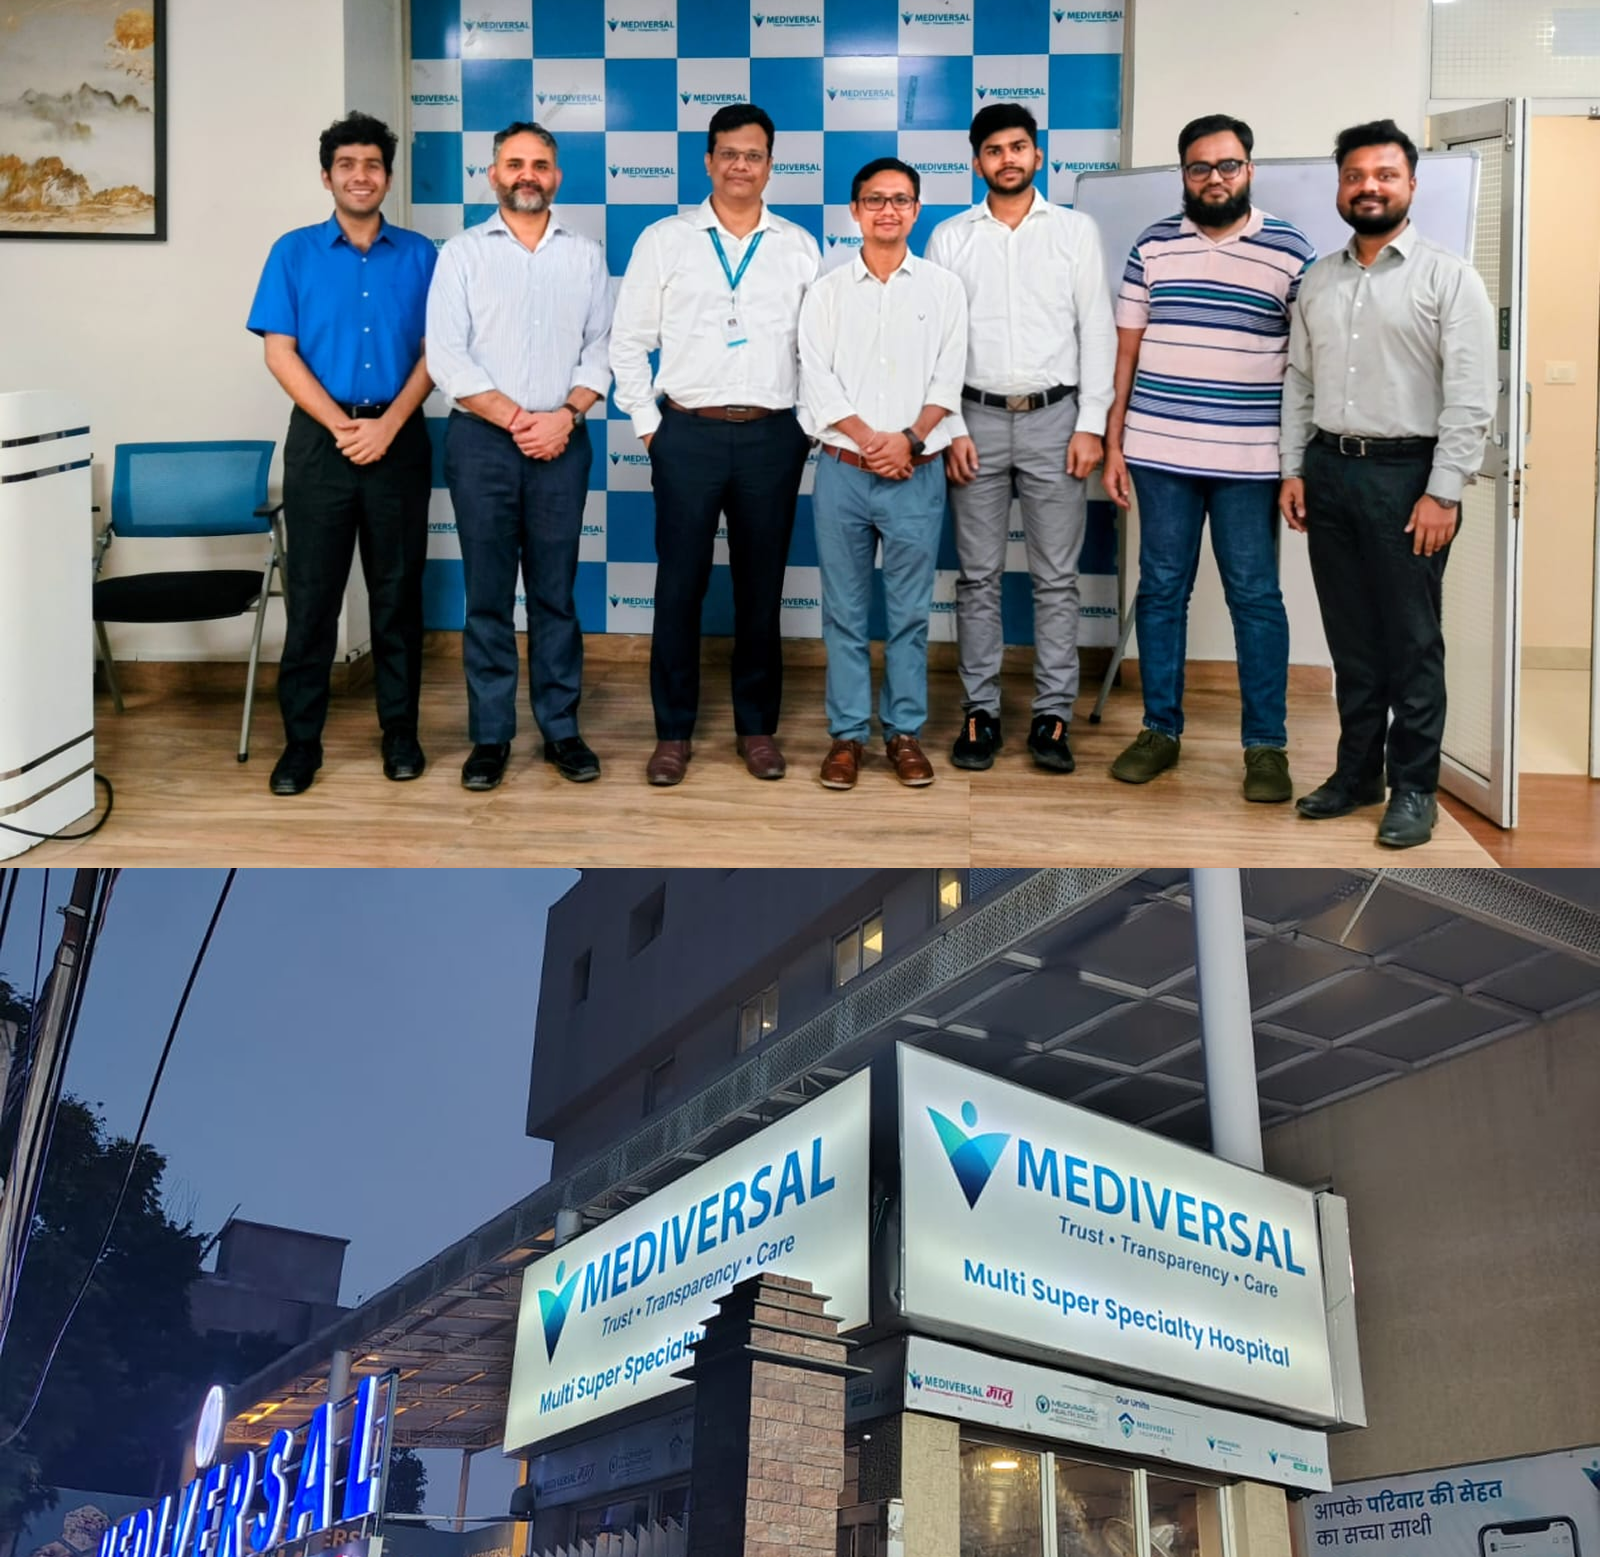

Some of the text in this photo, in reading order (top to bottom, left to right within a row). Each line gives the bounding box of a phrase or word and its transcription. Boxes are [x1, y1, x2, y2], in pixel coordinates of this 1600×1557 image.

[766, 15, 821, 24] MEDIVERSAL
[915, 12, 971, 22] MEDIVERSAL
[1067, 10, 1124, 20] MEDIVERSAL
[476, 21, 530, 30] MEDIVERSAL
[620, 20, 675, 29] MEDIVERSAL
[840, 88, 896, 98] MEDIVERSAL
[989, 87, 1046, 96] MEDIVERSAL
[549, 93, 603, 103] MEDIVERSAL
[693, 93, 748, 102] MEDIVERSAL
[621, 166, 676, 175] MEDIVERSAL
[772, 162, 822, 172] EDIVERSAL
[914, 162, 970, 171] MEDIVERSAL
[1016, 1138, 1306, 1276] MEDIVERSAL
[580, 1136, 835, 1313] MEDIVERSAL
[1059, 1216, 1279, 1299] Trust Transparency Care
[602, 1234, 796, 1338] Trust Transparency Care
[963, 1258, 1291, 1368] Multi Super Specialty Hospital
[539, 1382, 575, 1415] Multi
[577, 1364, 622, 1403] Super
[924, 1375, 984, 1398] MEDIVERSAL
[1314, 1478, 1503, 1521] आपके परिवार की सेहत
[1315, 1512, 1433, 1547] का सच्चा साथी
